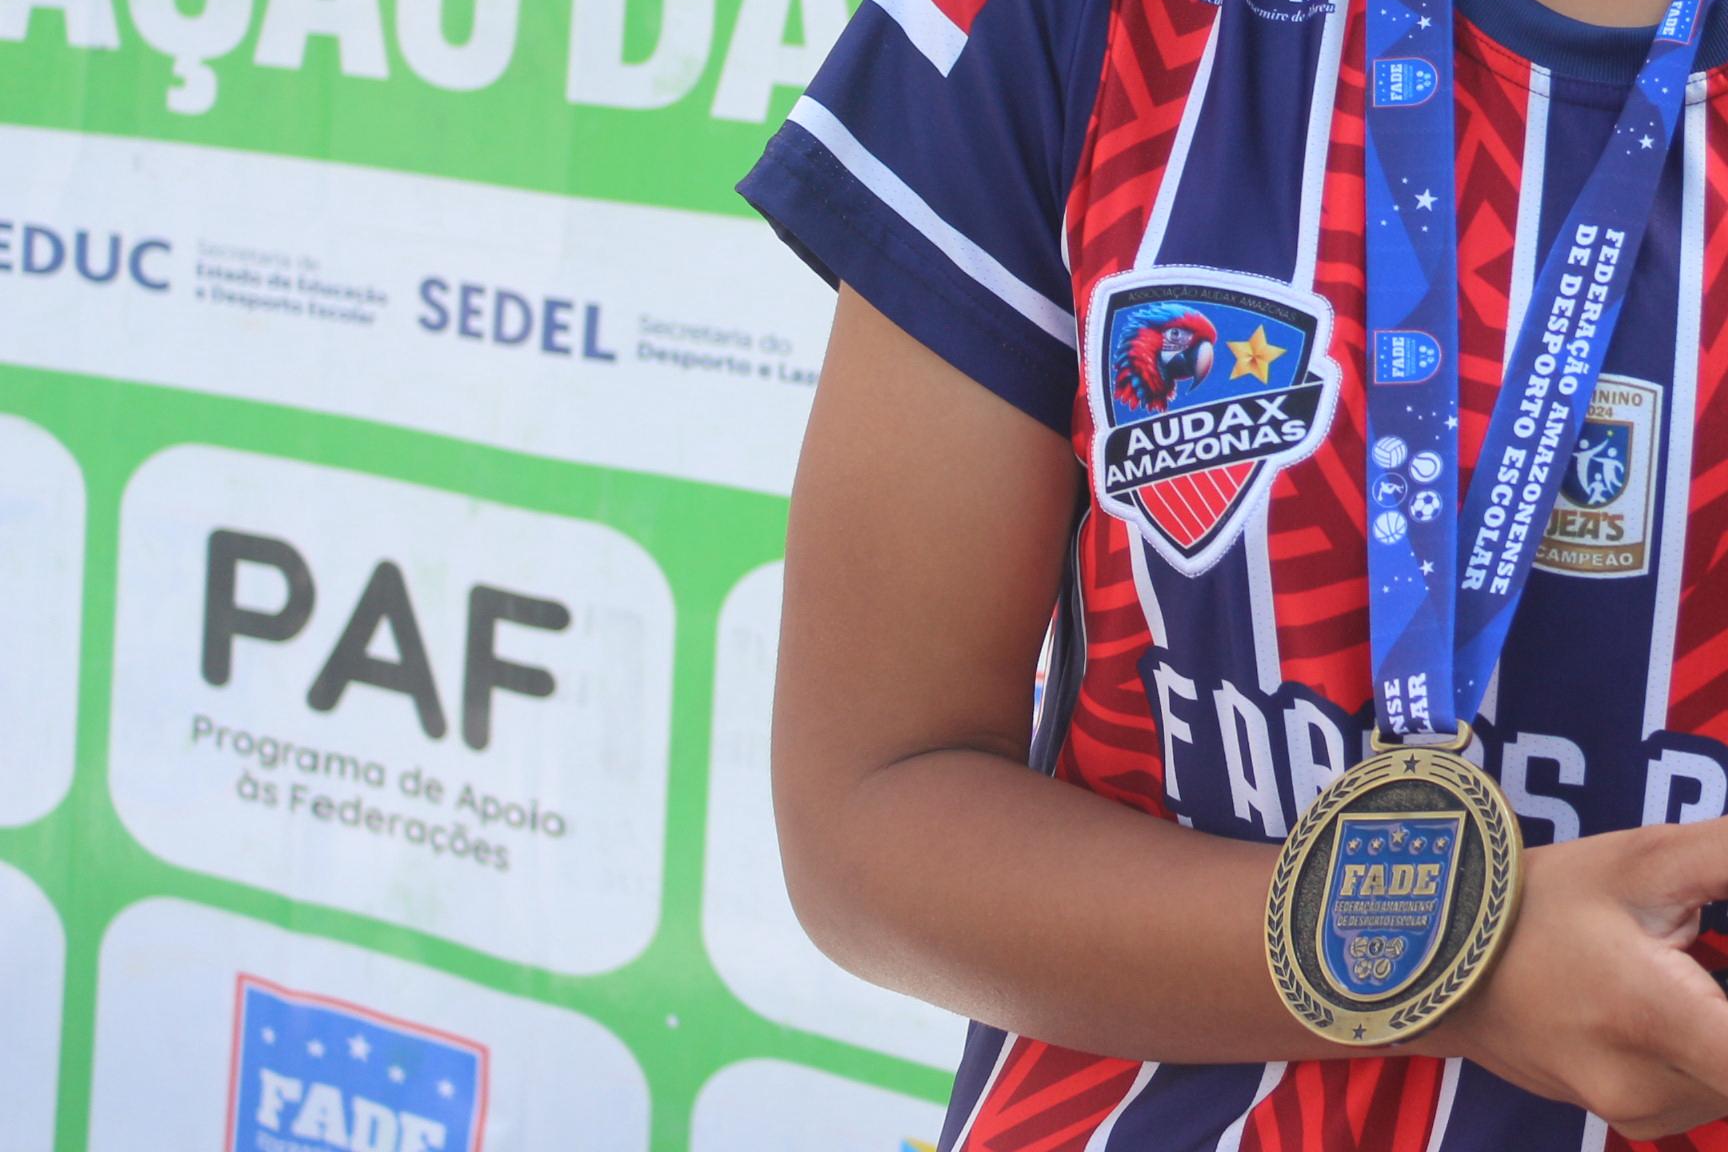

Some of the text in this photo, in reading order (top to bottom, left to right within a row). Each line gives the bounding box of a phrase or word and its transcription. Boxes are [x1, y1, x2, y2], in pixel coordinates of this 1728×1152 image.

[1662, 1, 1683, 36] FADE
[1390, 64, 1403, 101] FADE
[418, 277, 617, 365] SEDEL
[637, 340, 751, 374] Desporto
[1392, 337, 1405, 378] FADE
[1127, 394, 1290, 457] AUDAX
[1461, 223, 1597, 591] DE DESPORTO ESCOLAR
[1490, 228, 1624, 596] FEDERAÇÃO AMAZONENSE
[1587, 406, 1614, 418] 024
[1106, 420, 1307, 488] AMAZONAS
[201, 528, 571, 751] PAF
[191, 713, 566, 840] Programa de Apoio
[236, 771, 510, 873] às Federações
[1340, 863, 1440, 896] FADE
[256, 1067, 447, 1152] FADE
